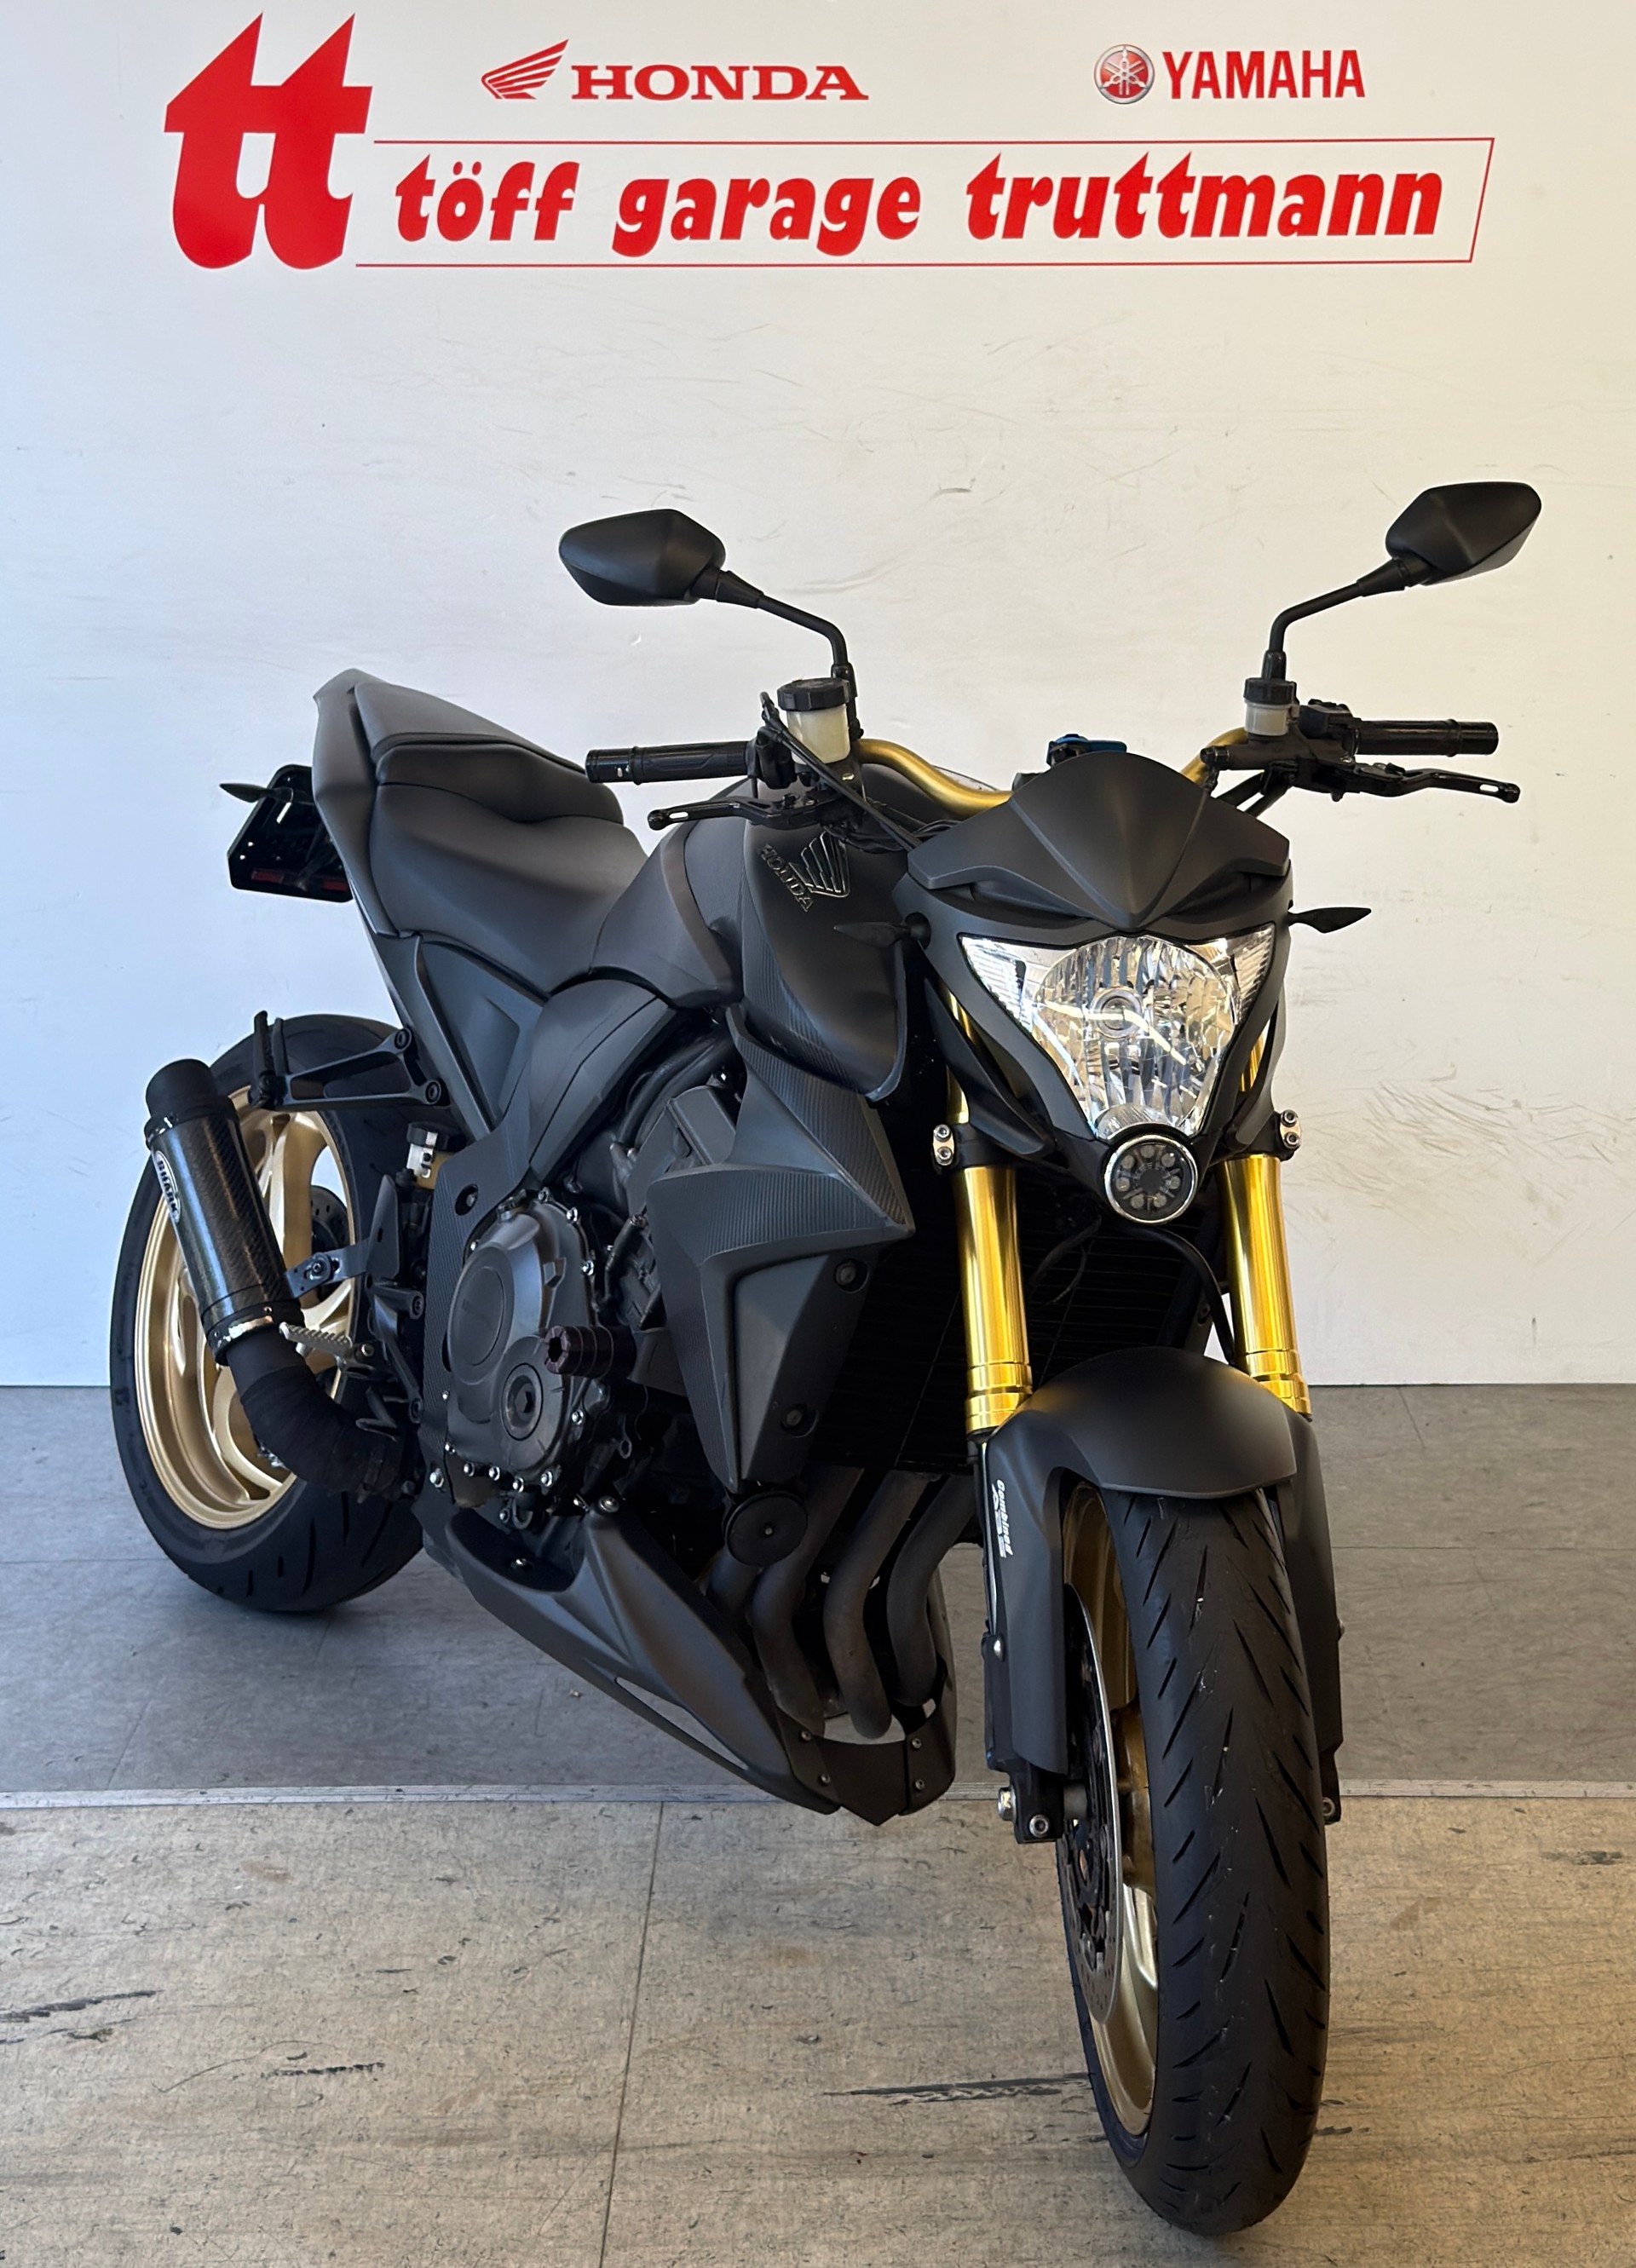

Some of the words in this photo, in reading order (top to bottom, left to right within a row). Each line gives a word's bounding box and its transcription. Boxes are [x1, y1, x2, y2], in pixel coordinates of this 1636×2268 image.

[571, 64, 869, 101] HONDA
[1162, 49, 1366, 100] YAMAHA
[395, 154, 580, 243] töff
[612, 176, 922, 257] garage
[966, 152, 1443, 240] truttmann
[758, 843, 814, 912] HONDA
[157, 1160, 177, 1212] SHARK
